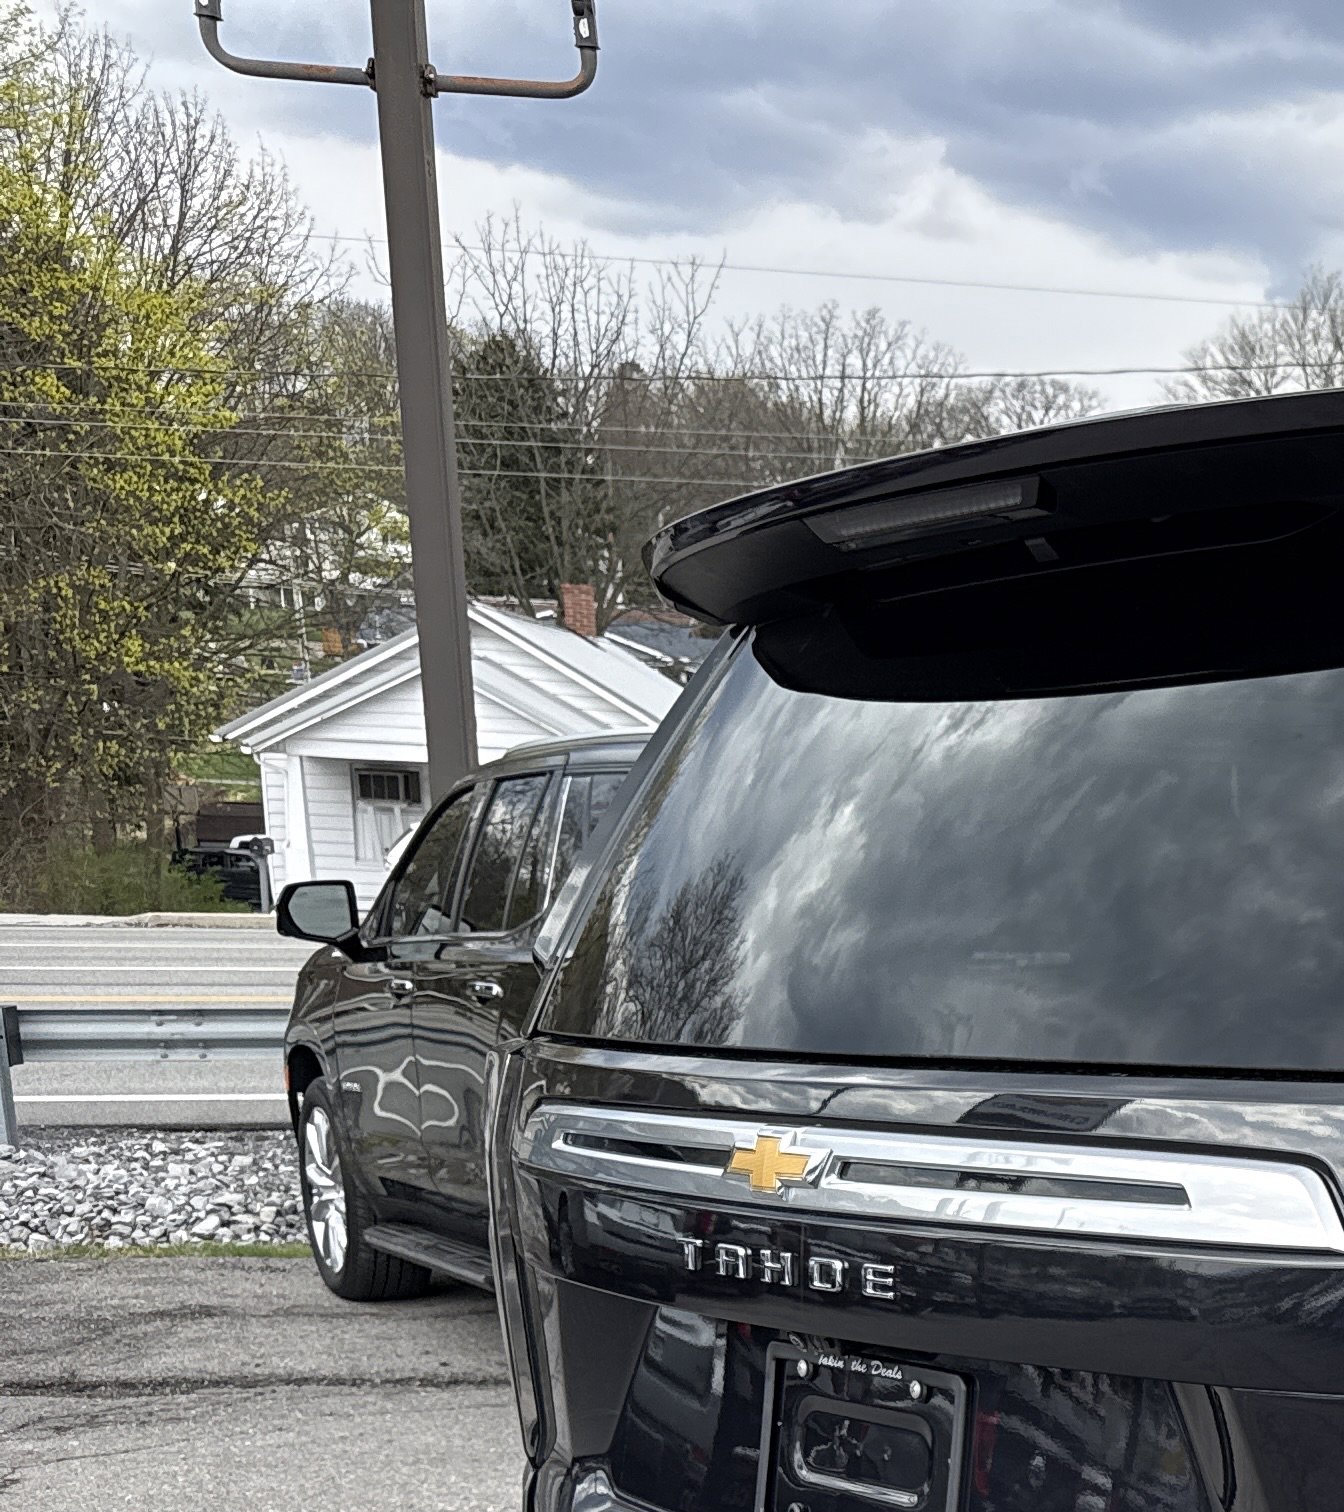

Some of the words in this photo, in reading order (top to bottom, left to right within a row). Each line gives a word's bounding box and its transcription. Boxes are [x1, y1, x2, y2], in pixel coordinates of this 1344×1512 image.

[677, 1237, 896, 1300] TAHOE
[851, 1359, 867, 1373] the
[870, 1360, 902, 1379] Deals
